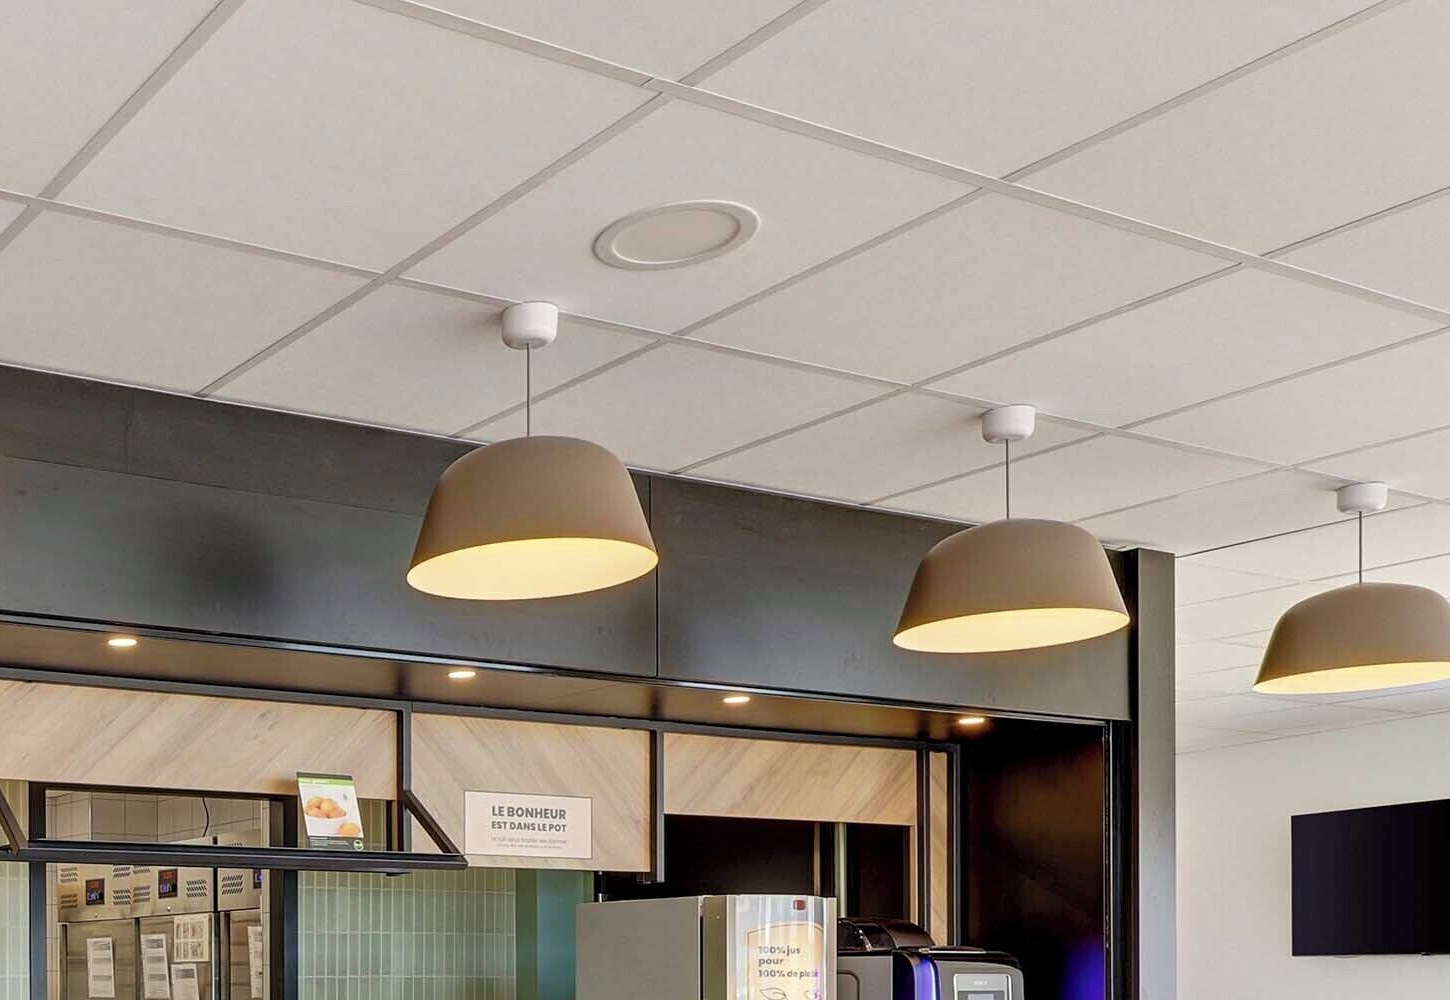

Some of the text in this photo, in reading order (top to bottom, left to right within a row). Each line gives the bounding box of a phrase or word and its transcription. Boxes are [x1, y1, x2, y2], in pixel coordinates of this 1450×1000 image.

[491, 806, 567, 820] LE BONHEUR
[491, 820, 567, 832] EST DANS LE POT
[758, 945, 800, 956] 100% jus
[758, 958, 784, 967] pour
[758, 969, 785, 978] 100%
[787, 969, 798, 977] de
